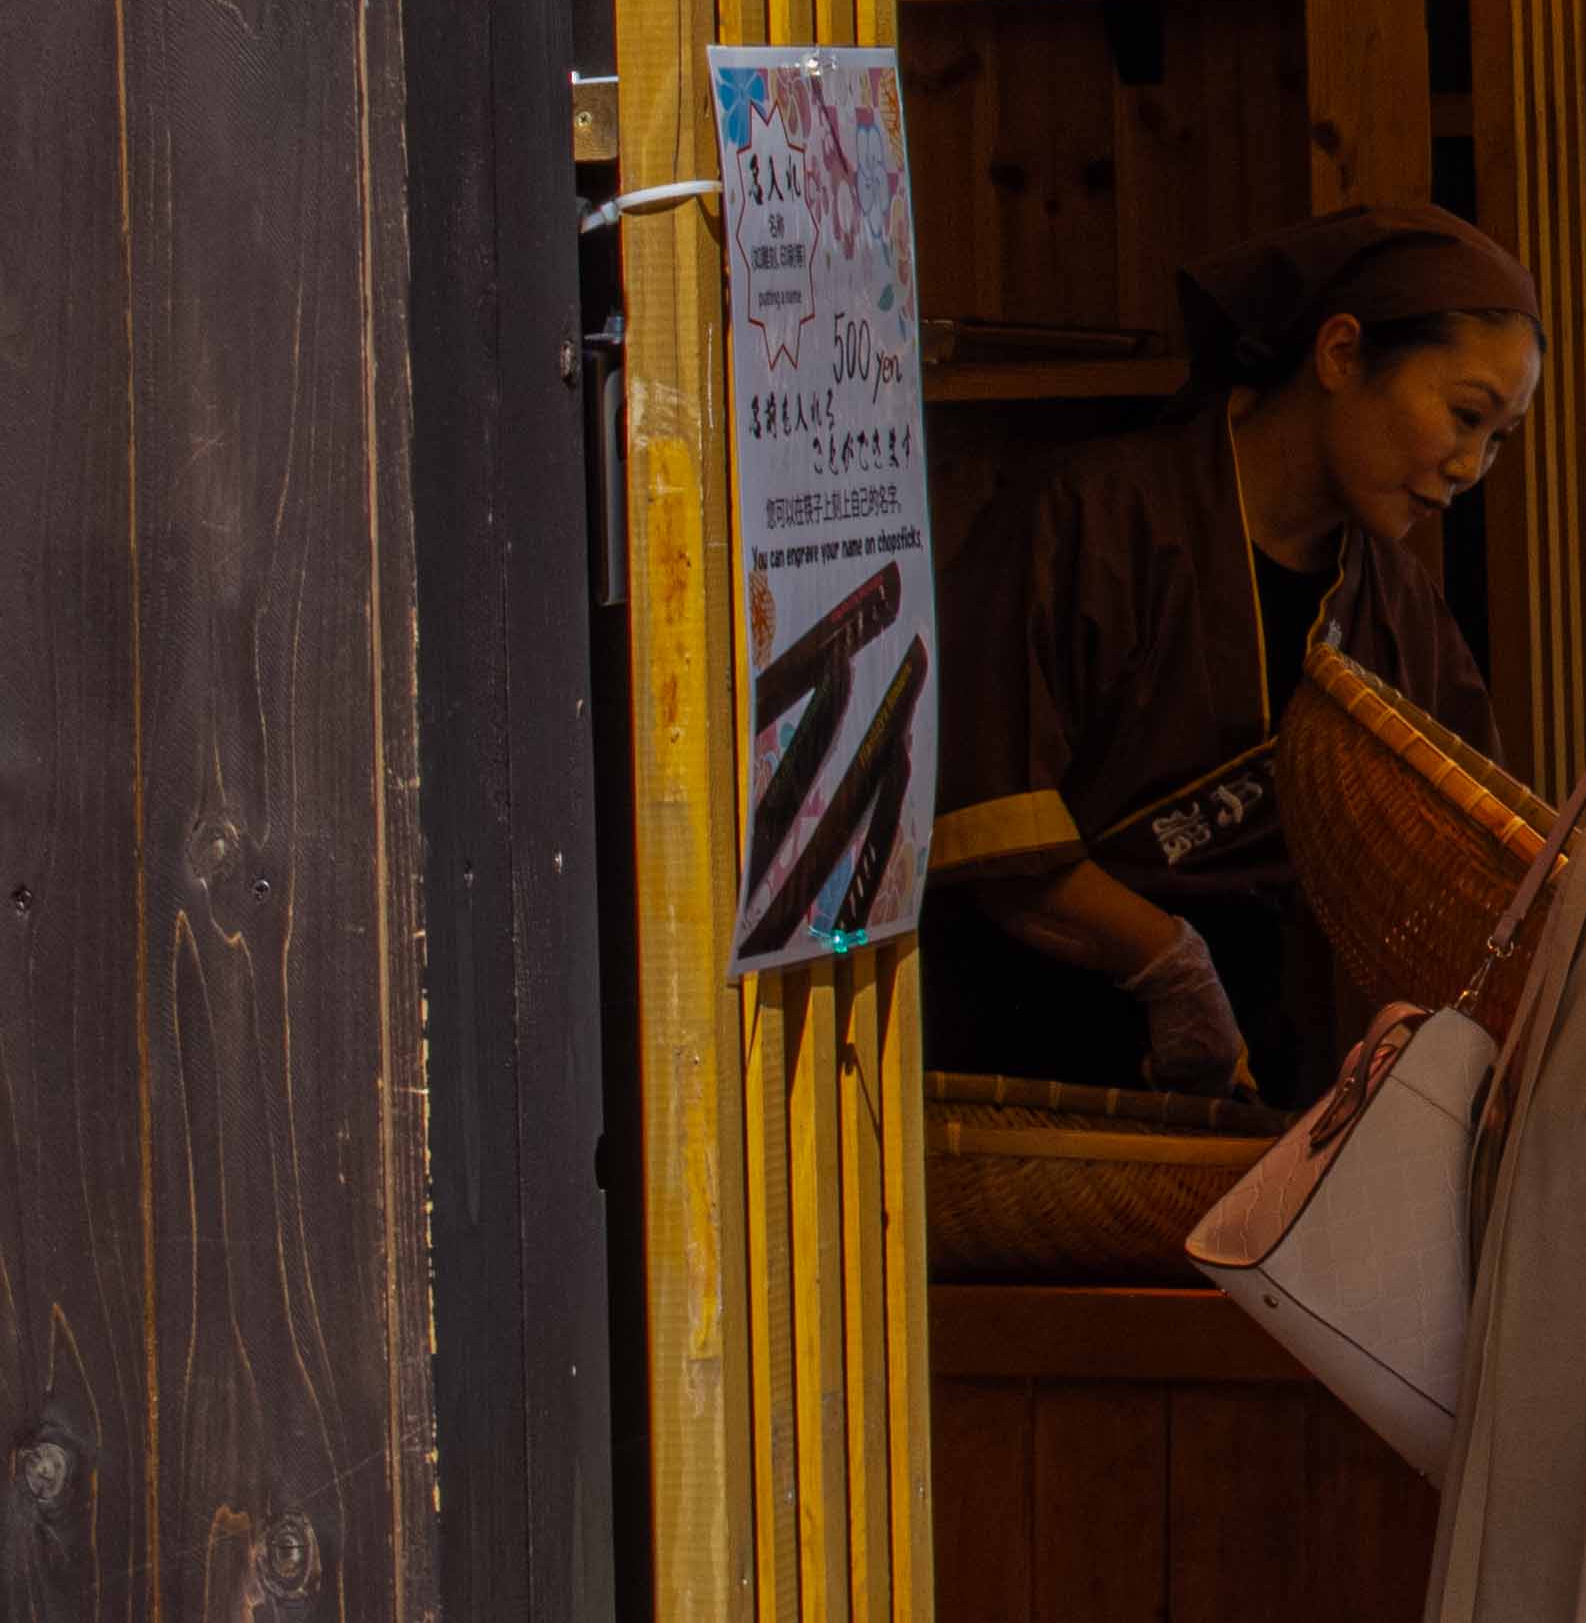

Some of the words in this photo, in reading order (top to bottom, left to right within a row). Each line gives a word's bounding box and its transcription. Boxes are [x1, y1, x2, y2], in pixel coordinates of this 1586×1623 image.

[832, 312, 871, 386] 500
[872, 353, 903, 403] yen
[812, 425, 912, 475] ことができます
[751, 545, 768, 570] You
[769, 548, 785, 569] can
[786, 543, 819, 569] engrave
[820, 541, 840, 565] your
[841, 537, 863, 558] name
[865, 535, 876, 555] on
